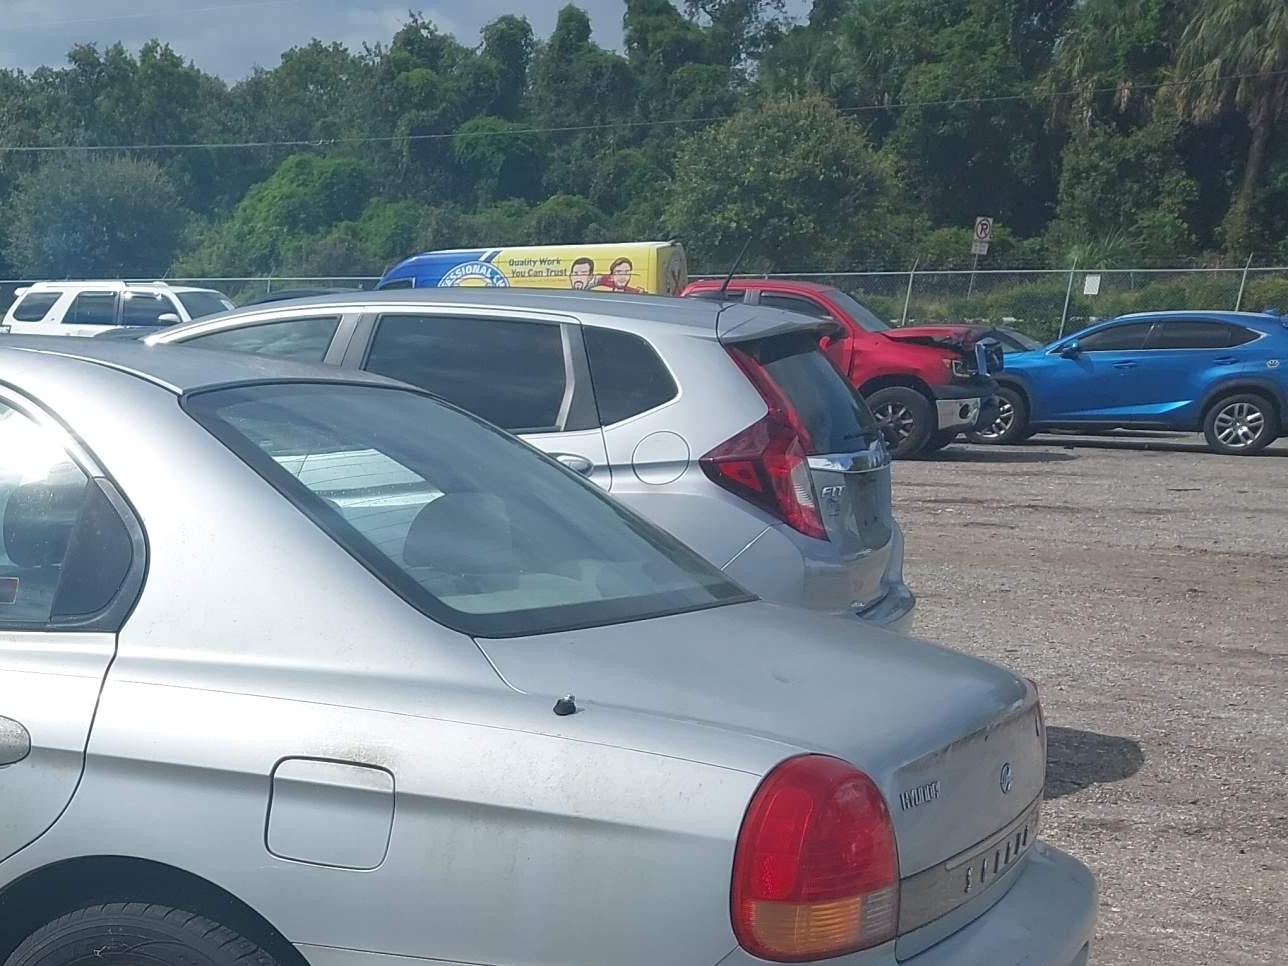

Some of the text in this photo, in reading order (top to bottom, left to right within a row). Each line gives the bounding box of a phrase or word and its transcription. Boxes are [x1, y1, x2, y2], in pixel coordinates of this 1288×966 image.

[508, 257, 561, 267] Quality Work
[512, 268, 568, 277] You Can Trust
[821, 485, 846, 498] FIT
